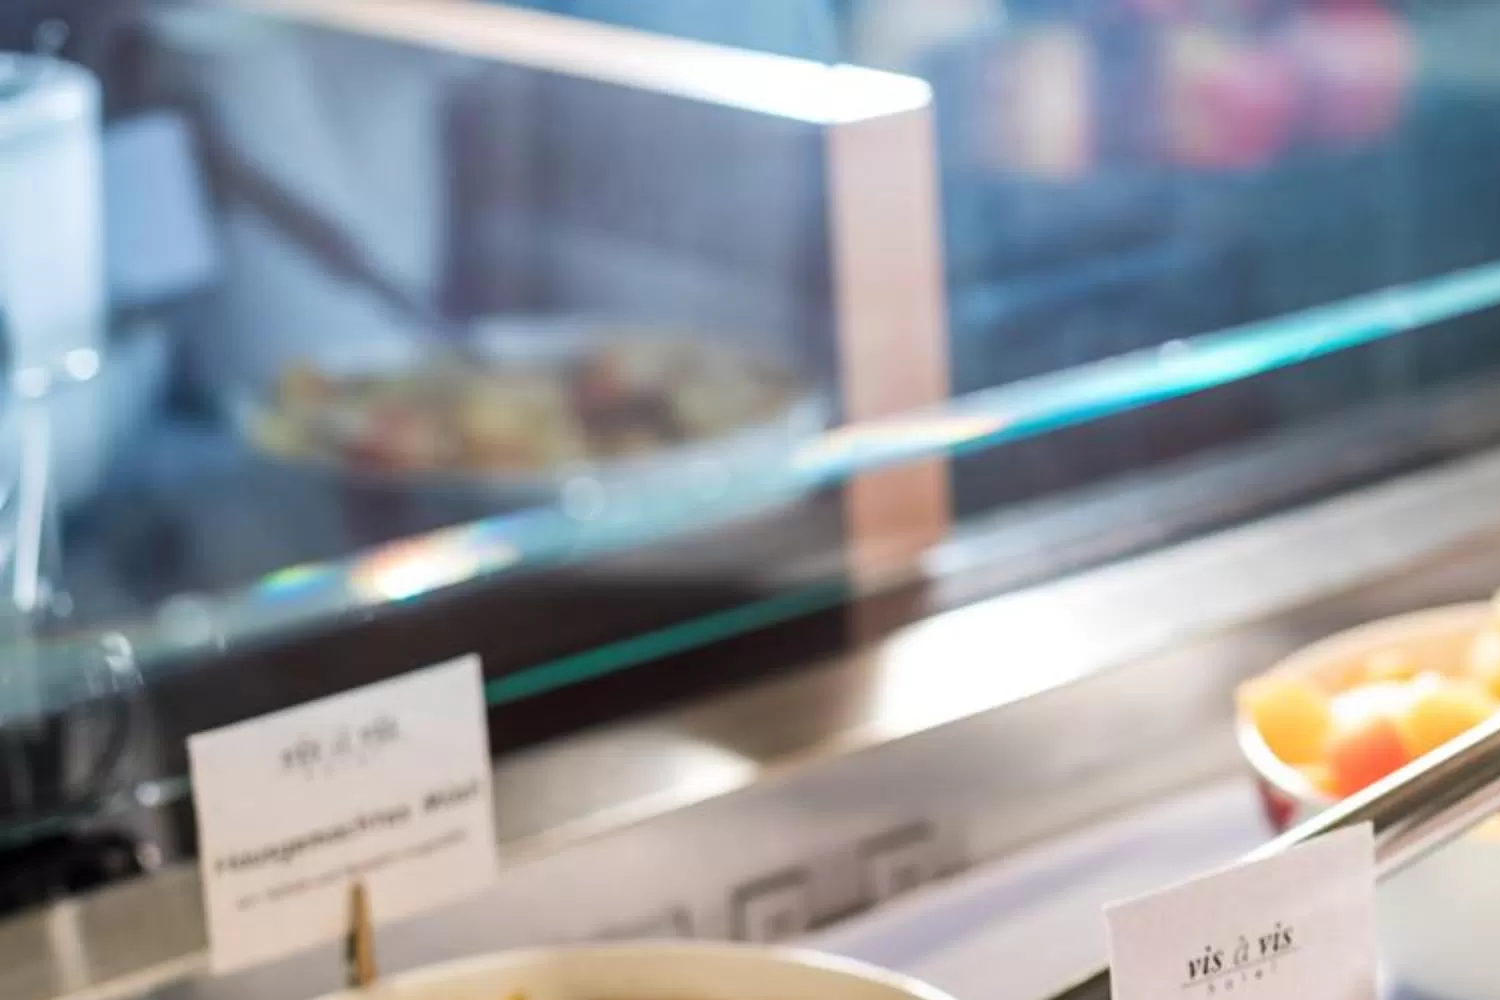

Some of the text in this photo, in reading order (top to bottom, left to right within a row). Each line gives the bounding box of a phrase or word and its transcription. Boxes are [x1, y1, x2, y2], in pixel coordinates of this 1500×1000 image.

[1187, 921, 1295, 979] vis à vis
